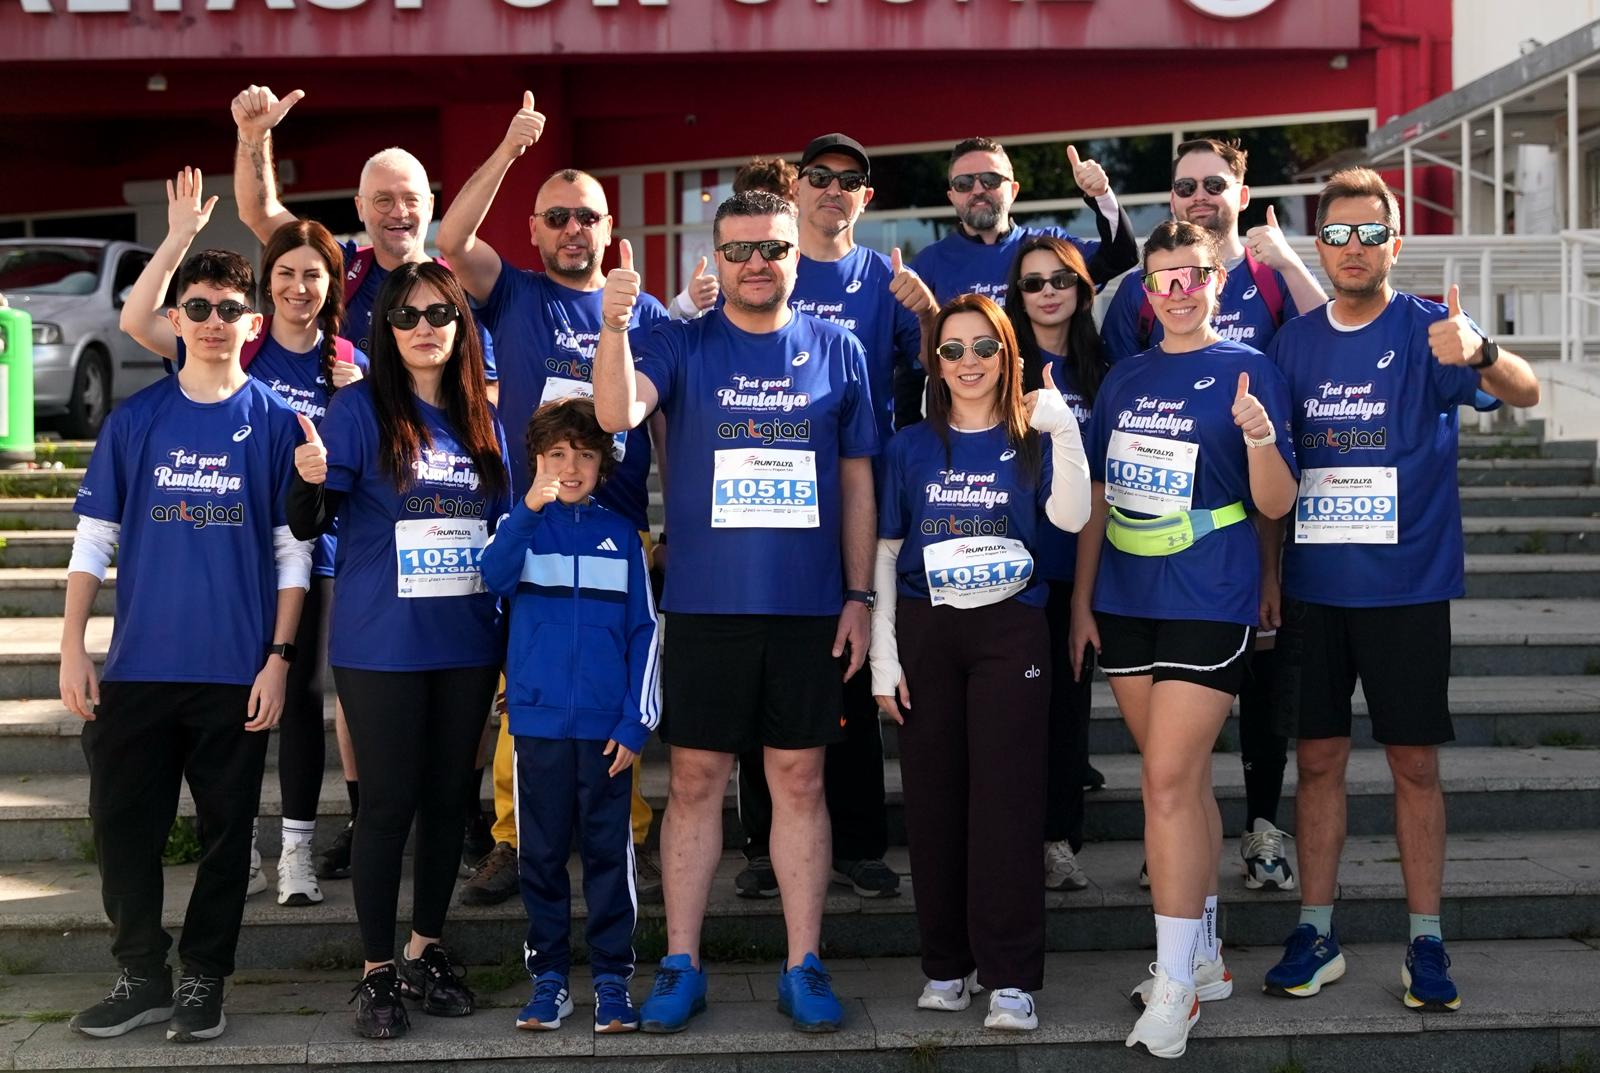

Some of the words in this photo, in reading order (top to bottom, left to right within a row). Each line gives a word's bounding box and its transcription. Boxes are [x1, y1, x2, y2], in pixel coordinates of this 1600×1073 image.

[992, 284, 1009, 294] goo
[817, 303, 843, 315] good
[1215, 311, 1240, 325] good
[545, 357, 593, 382] antg
[291, 388, 315, 398] good
[762, 378, 790, 391] good
[1345, 383, 1372, 398] good
[717, 389, 808, 412] Runtalya
[1158, 401, 1185, 412] good
[1304, 398, 1386, 421] Runtalya
[717, 418, 810, 445] antgiad
[1118, 410, 1194, 436] Runtalya
[1302, 426, 1386, 454] antgiad
[1137, 446, 1174, 457] RUNTALYA
[199, 455, 228, 469] good
[154, 466, 241, 494] Runtalya
[412, 461, 479, 490] Runtaly
[967, 473, 996, 485] good
[1110, 461, 1188, 489] 10513
[720, 480, 812, 498] 10515
[1114, 478, 1180, 495] ANTGIAD
[726, 497, 806, 505] ANTGIAD
[926, 483, 1009, 509] Runtalya
[406, 494, 487, 518] antgiad
[1302, 497, 1392, 514] 10509
[151, 500, 243, 529] antgiad
[921, 514, 1008, 536] antgiad
[935, 560, 1028, 584] 10517
[943, 577, 1021, 590] ANTGIAD
[1025, 664, 1040, 678] alo
